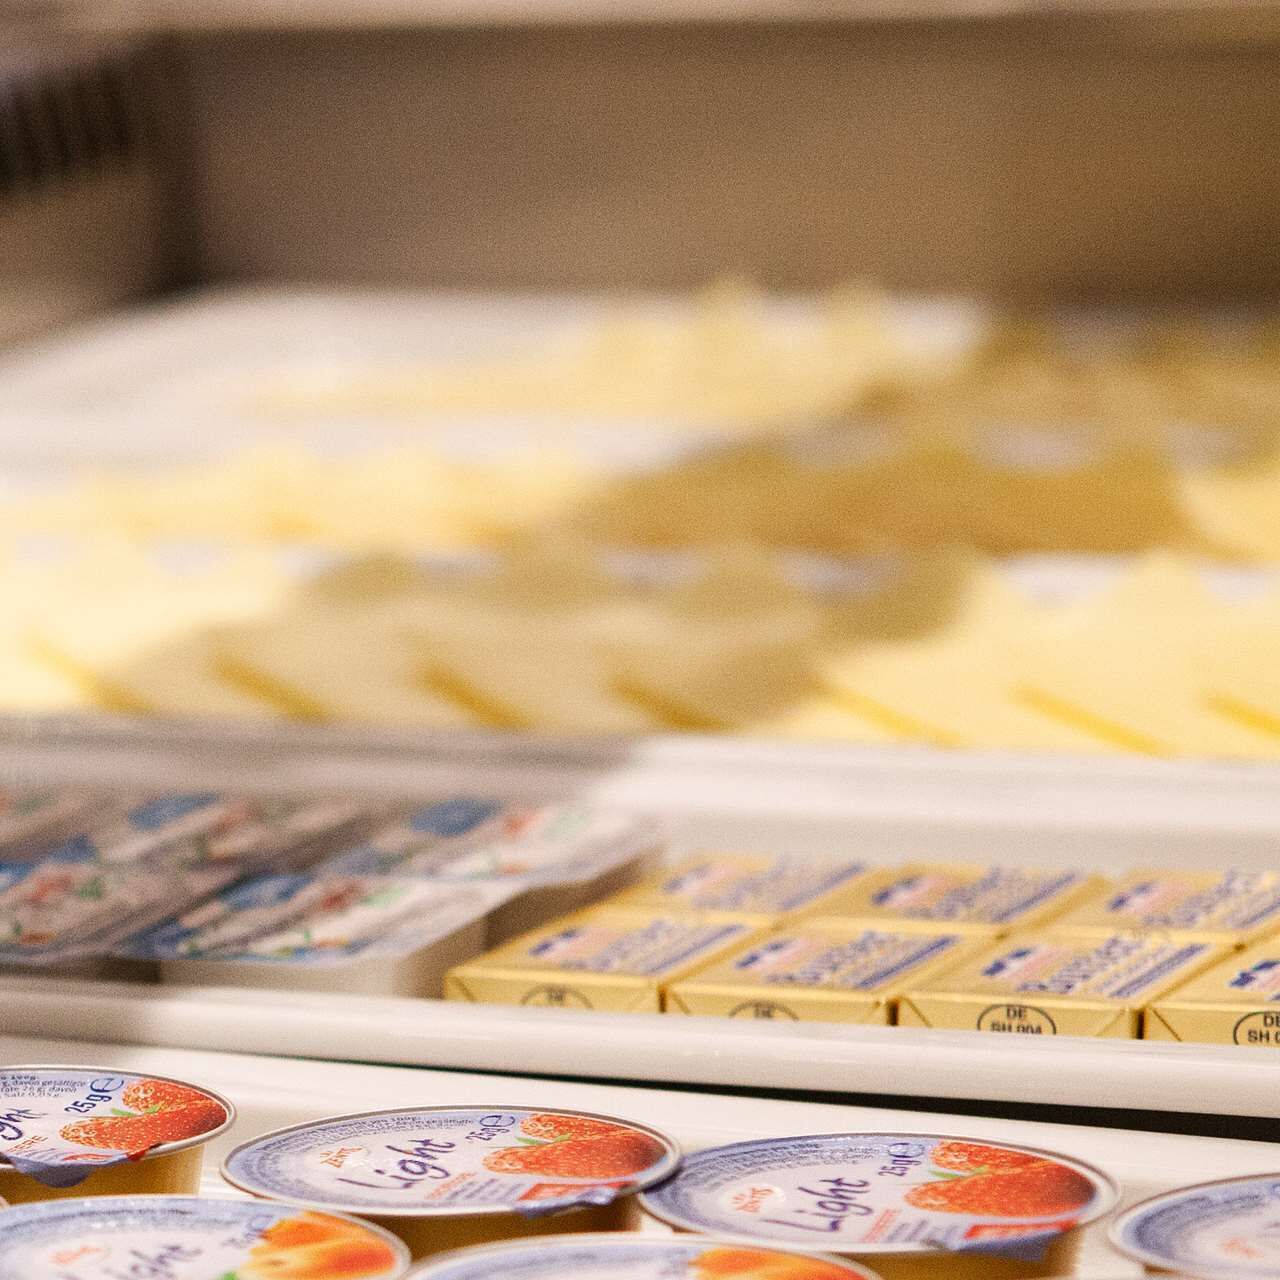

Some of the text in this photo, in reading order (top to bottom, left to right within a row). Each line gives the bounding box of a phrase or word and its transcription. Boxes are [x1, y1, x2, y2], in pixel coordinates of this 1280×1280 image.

[64, 1094, 112, 1114] 25g
[336, 1138, 456, 1189] Light
[878, 1159, 922, 1177] 25g
[760, 1177, 872, 1232] Light
